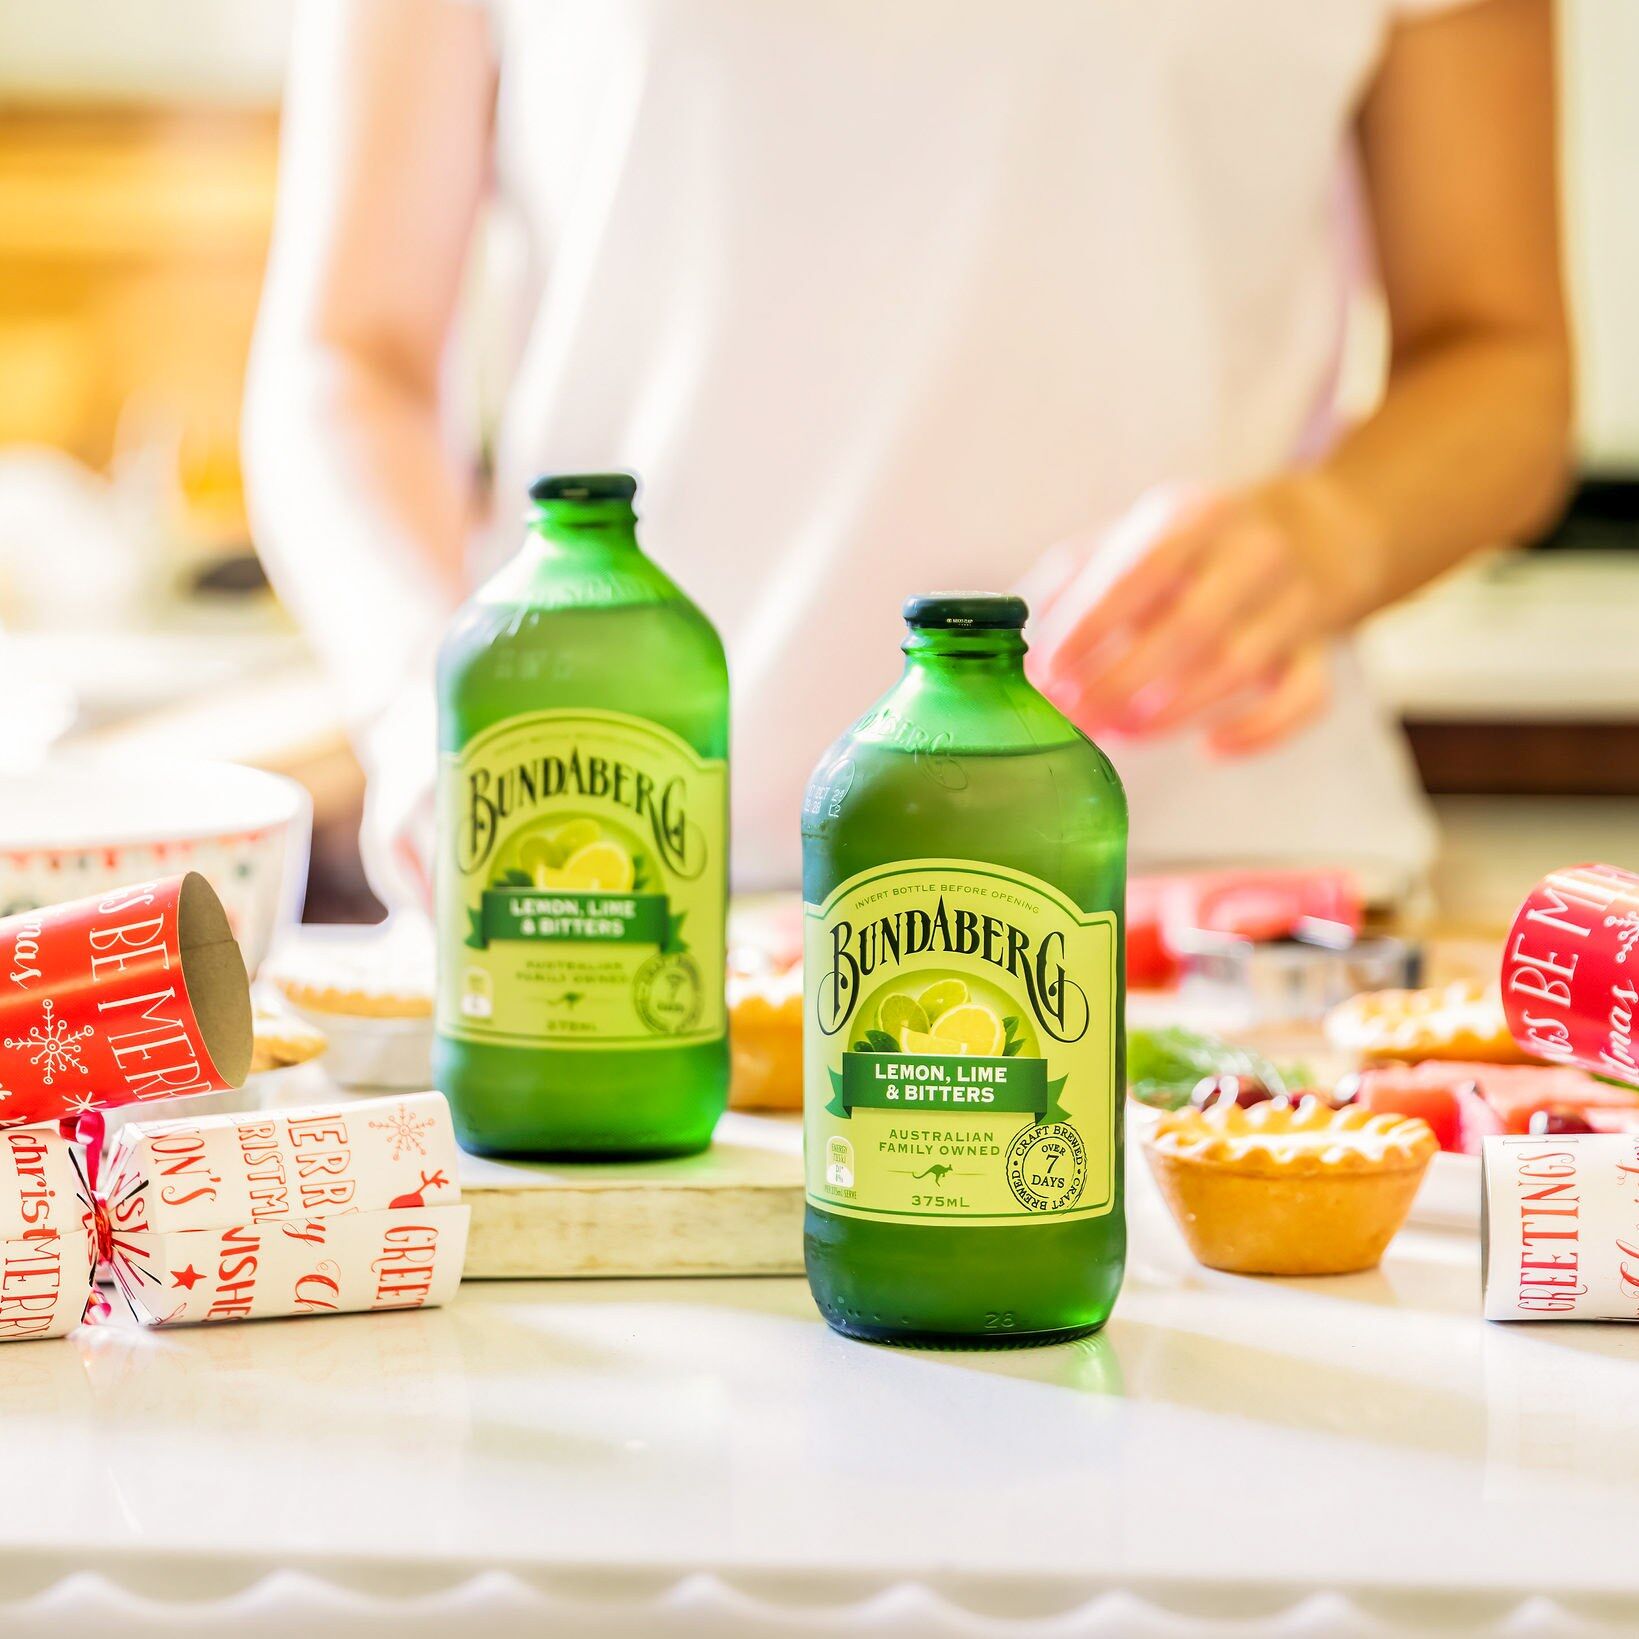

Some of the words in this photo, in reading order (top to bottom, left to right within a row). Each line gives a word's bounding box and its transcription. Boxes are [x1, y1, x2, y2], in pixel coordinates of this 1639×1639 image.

[456, 744, 707, 882] BUNDABERG
[855, 890, 889, 910] INVERT
[892, 884, 936, 896] BOTTLE
[940, 884, 988, 896] BEFORE
[991, 890, 1041, 914] OPENING
[539, 918, 625, 938] BITTERS
[89, 913, 170, 983] BE
[817, 894, 1090, 1043] BUNDABERG
[1509, 932, 1579, 1009] BE
[874, 1063, 952, 1085] LEMON,
[957, 1066, 1008, 1083] LIME
[885, 1085, 900, 1100] &
[904, 1085, 995, 1103] BITTERS
[879, 1142, 936, 1155] FAMILY
[939, 1145, 1001, 1156] OWNED
[888, 1129, 994, 1142] AUSTRALIAN
[1015, 1125, 1050, 1157] CRAFT
[1053, 1125, 1083, 1165] BREWED
[1041, 1144, 1066, 1156] OVER
[287, 1112, 361, 1214] ERR
[1046, 1154, 1059, 1173] 7
[1012, 1170, 1048, 1210] BREWED
[1031, 1174, 1065, 1188] DAYS
[1051, 1177, 1081, 1210] CRAFT
[1517, 1152, 1589, 1312] GREETINGS
